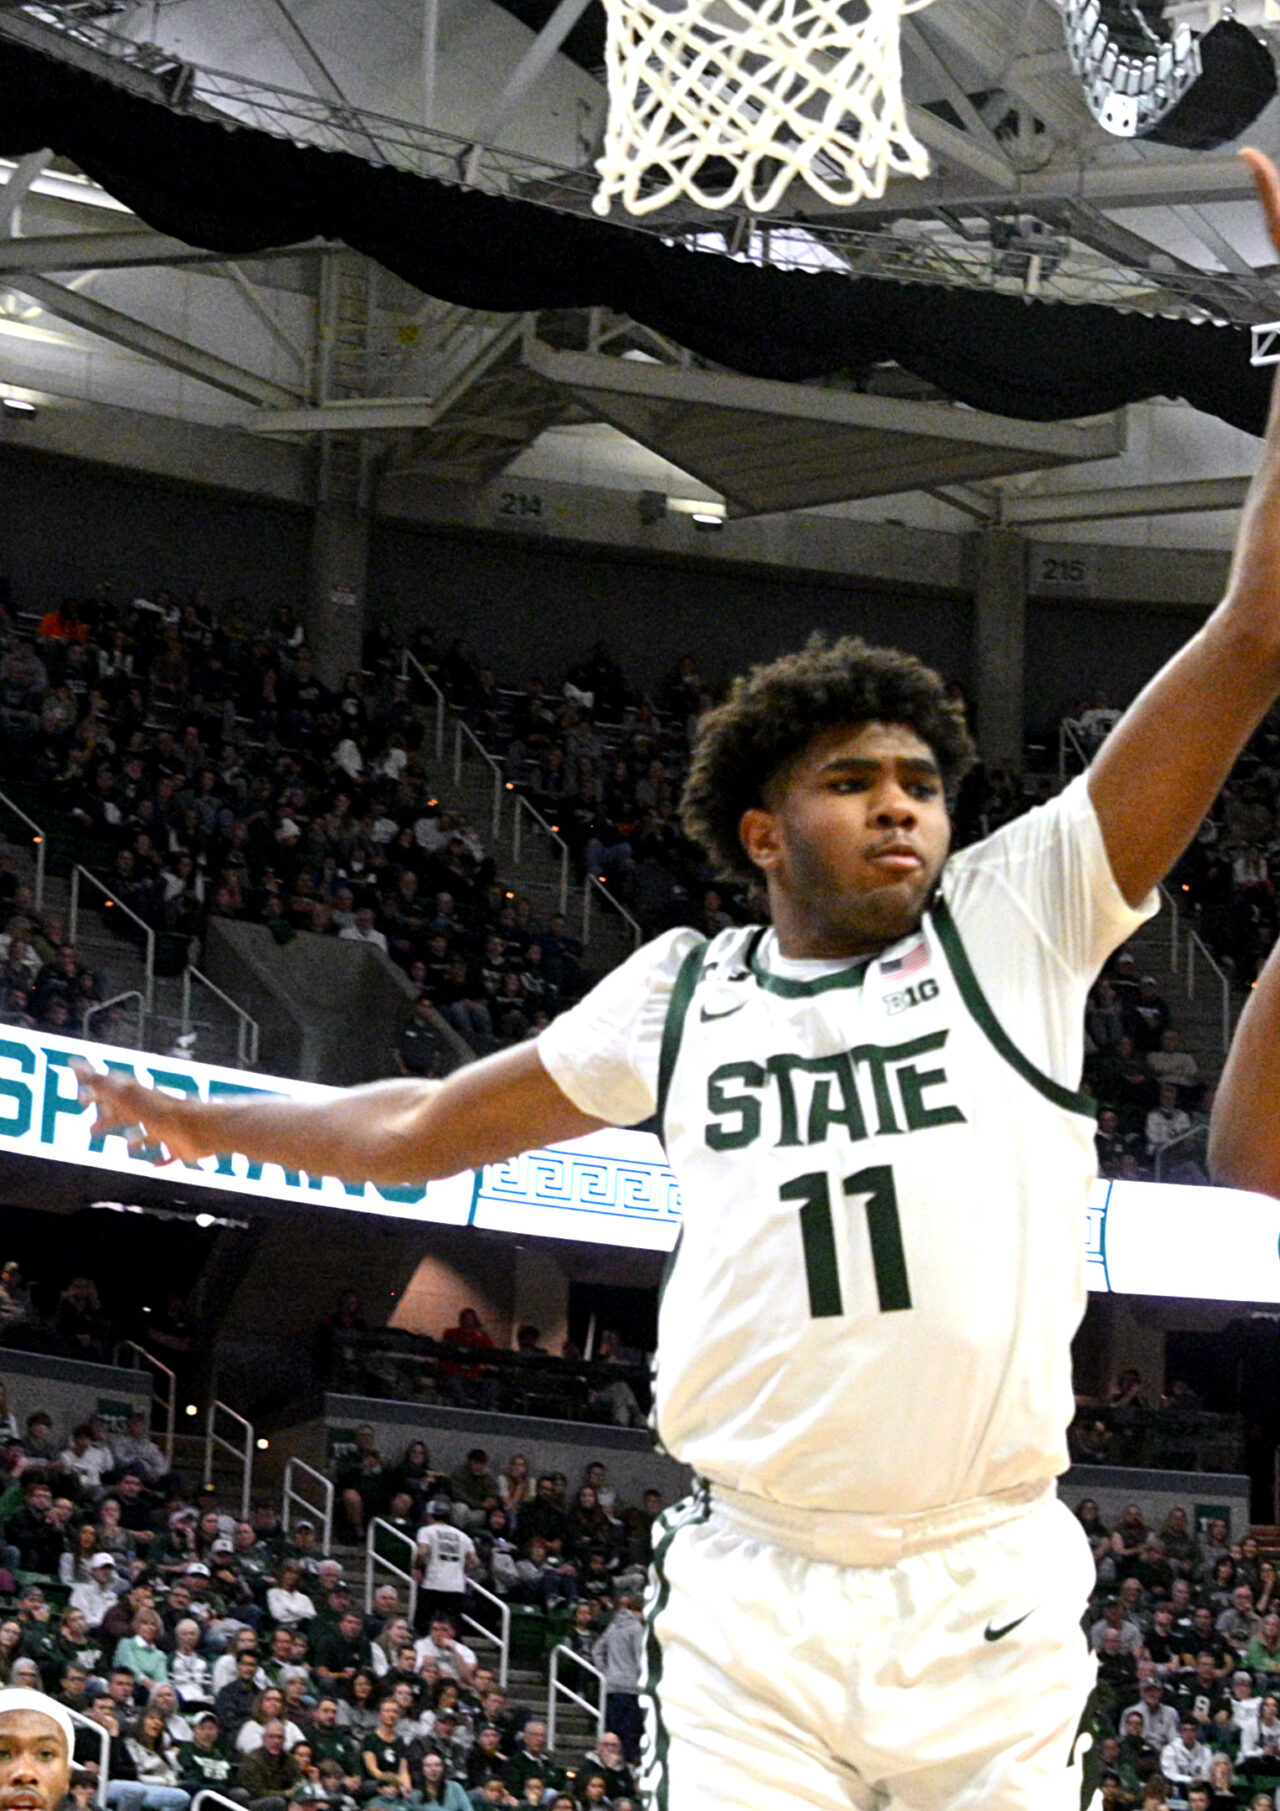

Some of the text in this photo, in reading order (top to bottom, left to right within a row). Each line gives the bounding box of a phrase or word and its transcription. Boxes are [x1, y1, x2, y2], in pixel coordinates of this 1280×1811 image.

[501, 493, 542, 515] 214
[1042, 558, 1085, 581] 215
[705, 1029, 967, 1151] STATE
[779, 1165, 912, 1318] 11
